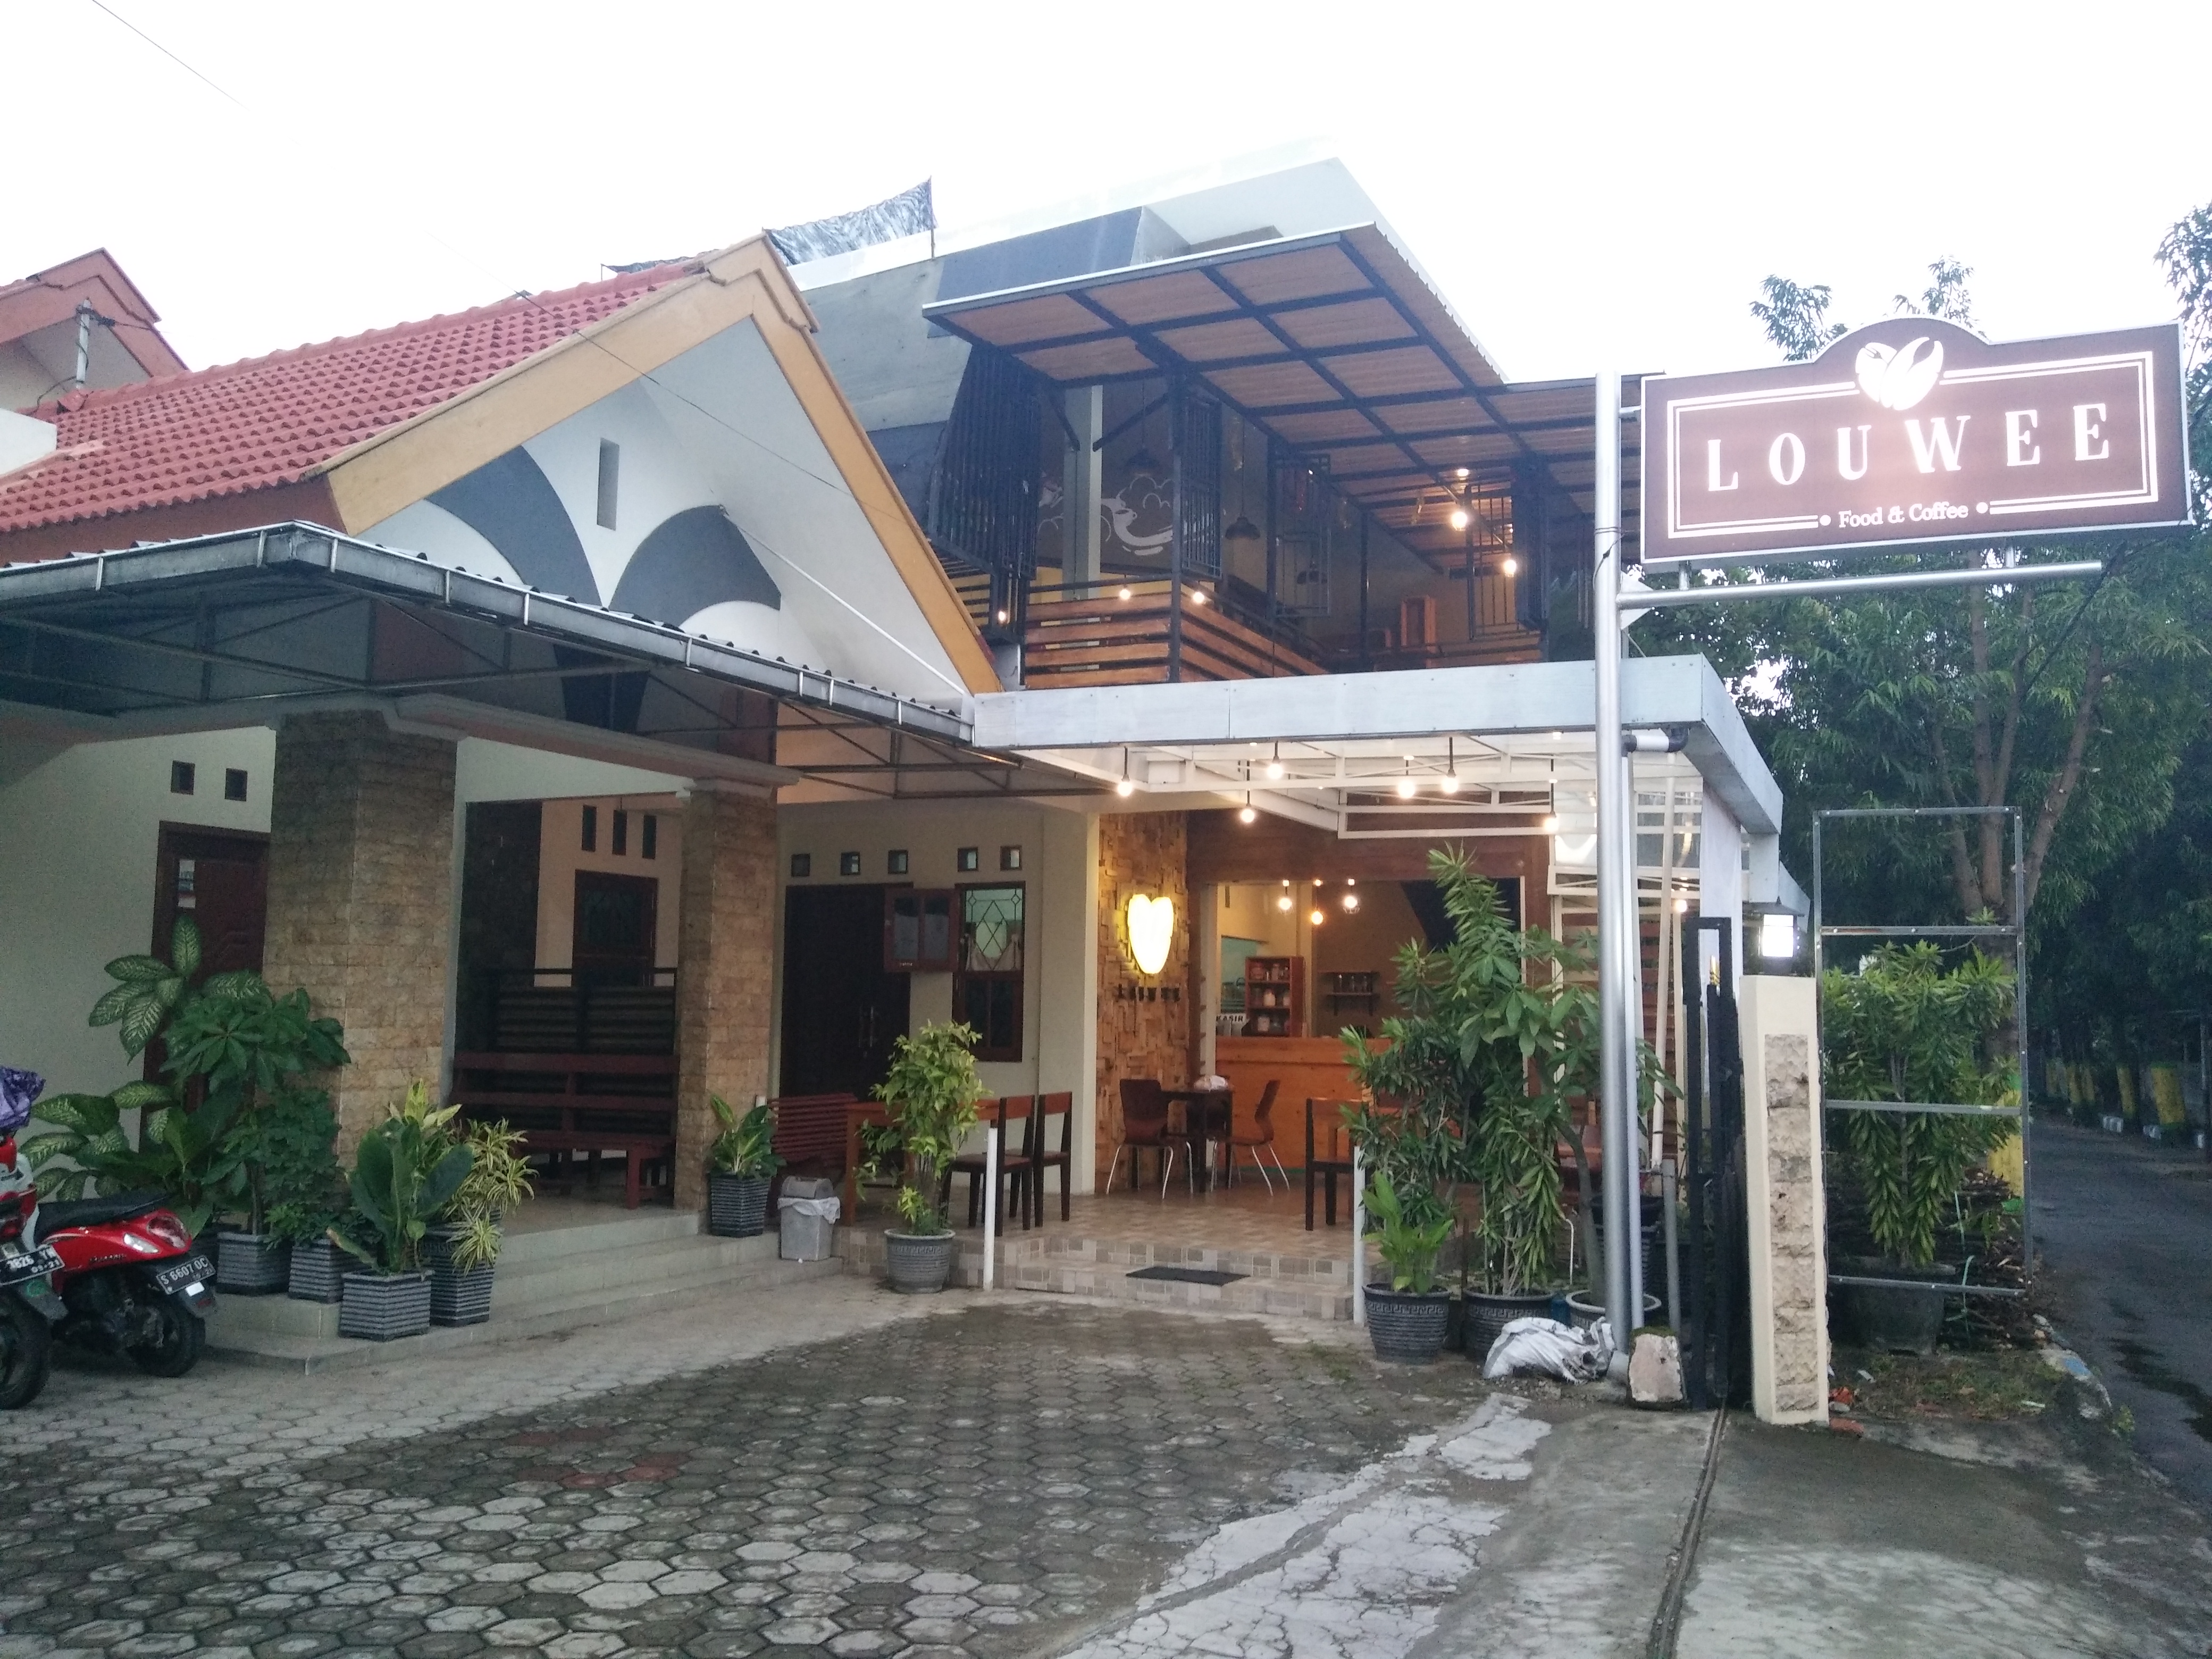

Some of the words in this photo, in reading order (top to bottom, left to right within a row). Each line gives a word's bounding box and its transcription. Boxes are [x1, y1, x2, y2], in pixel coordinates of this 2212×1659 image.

[1708, 403, 2109, 492] LOUWEE
[1838, 509, 1884, 528] Food
[1888, 505, 1905, 524] &
[1909, 501, 1969, 522] Coffee
[161, 1275, 169, 1285] S
